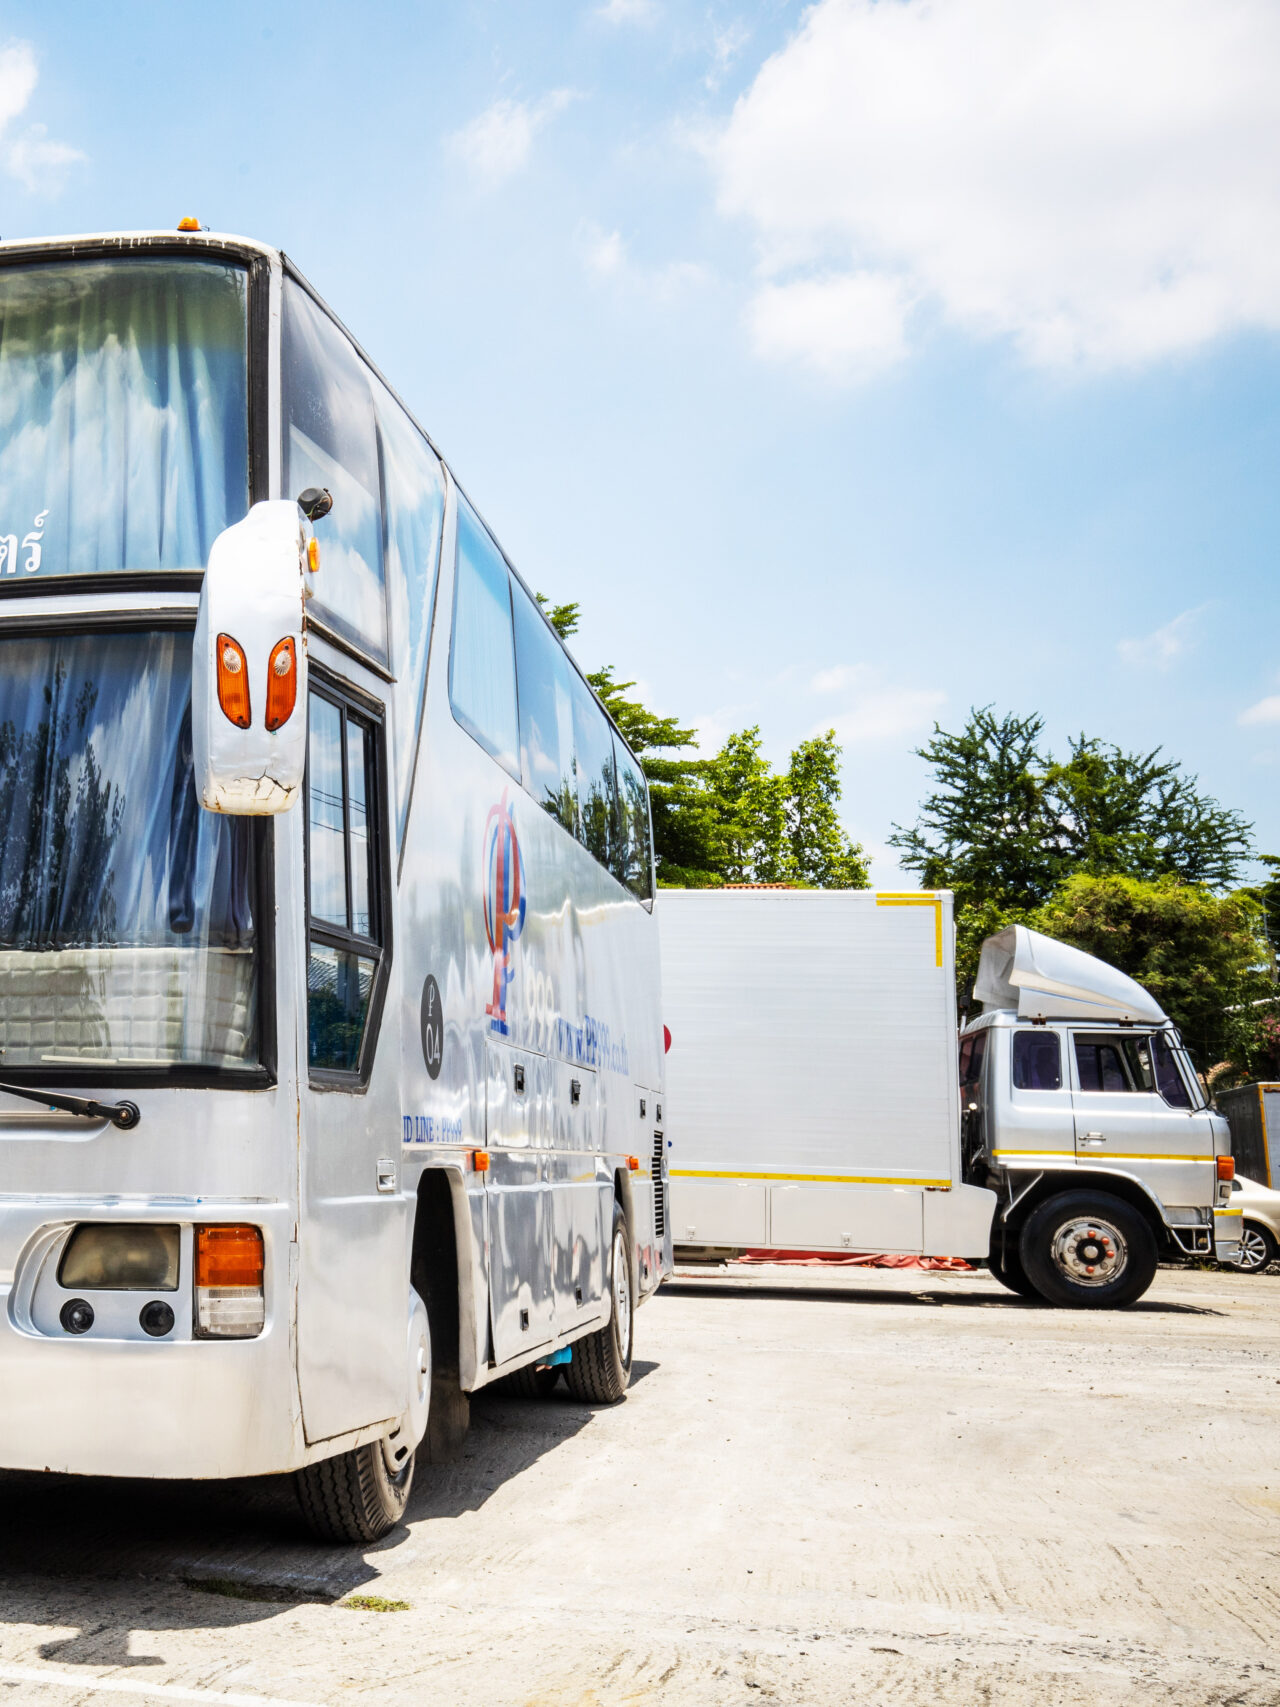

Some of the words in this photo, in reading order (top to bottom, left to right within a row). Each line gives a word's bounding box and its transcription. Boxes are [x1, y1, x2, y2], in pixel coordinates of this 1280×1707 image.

[426, 1023, 441, 1065] 04
[402, 1115, 413, 1143] ID
[415, 1115, 435, 1143] LINE
